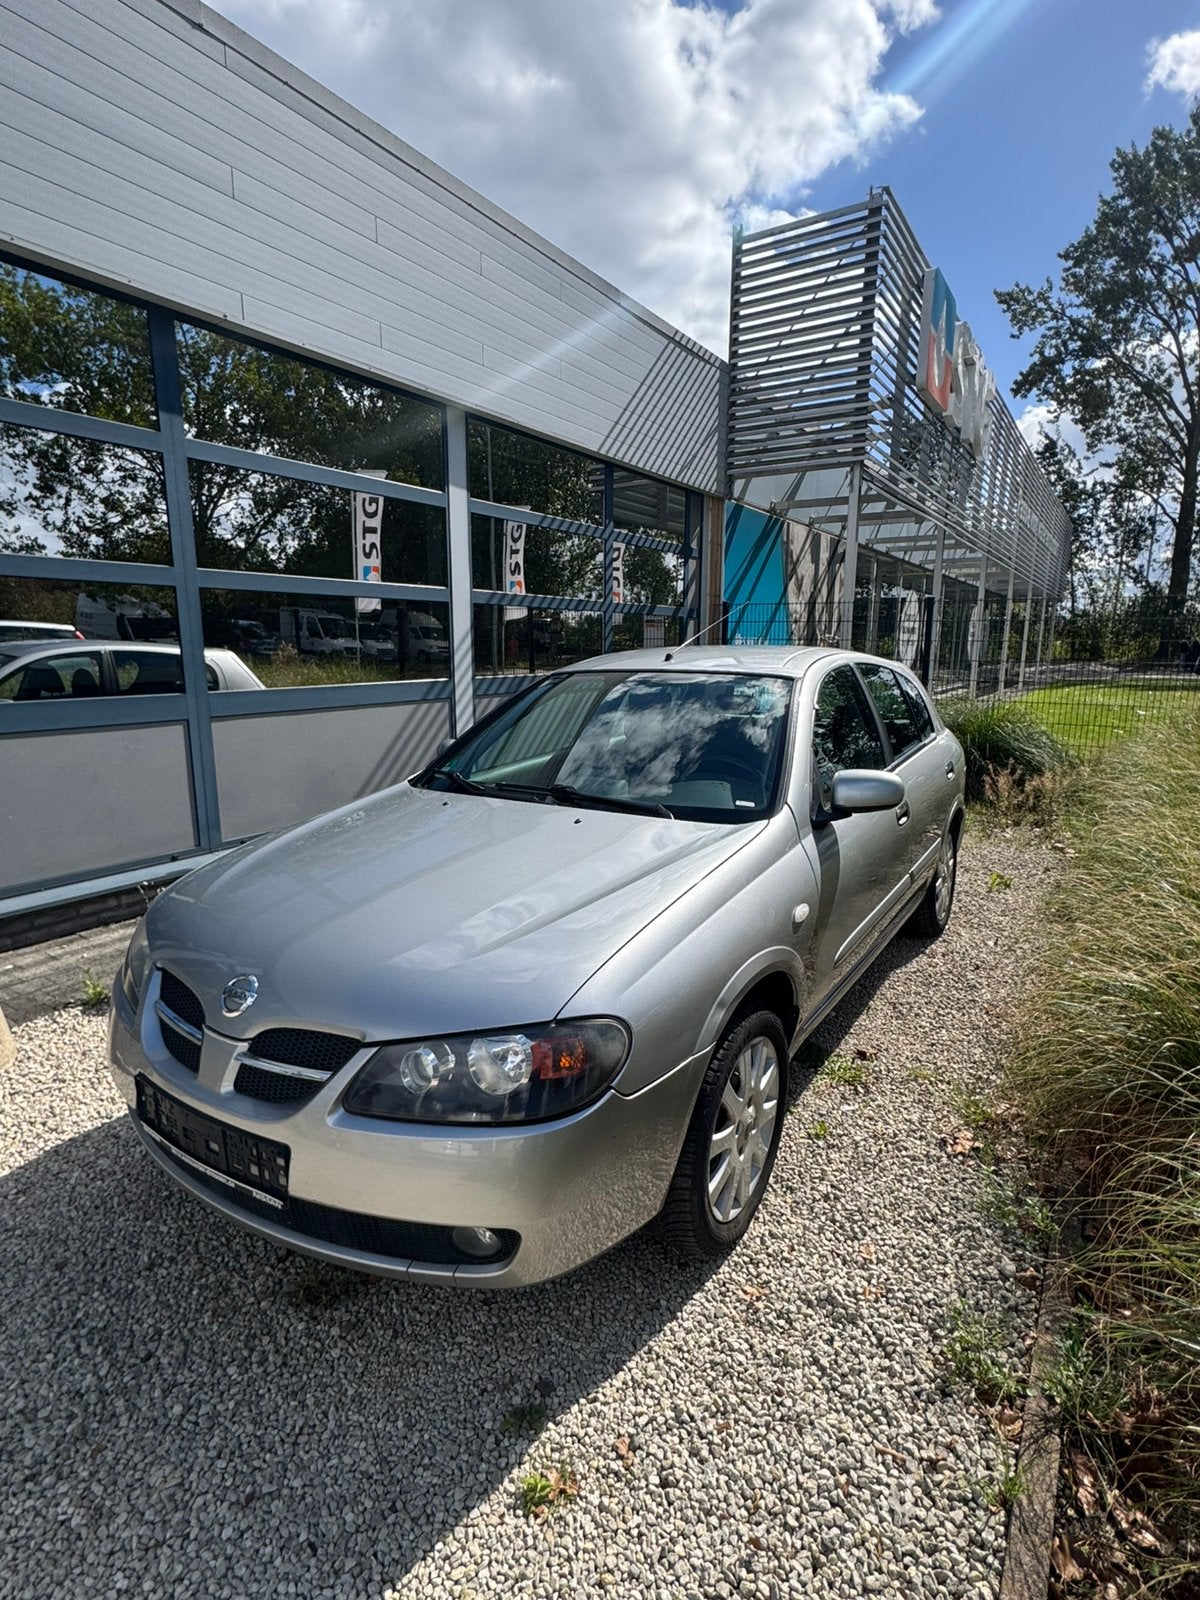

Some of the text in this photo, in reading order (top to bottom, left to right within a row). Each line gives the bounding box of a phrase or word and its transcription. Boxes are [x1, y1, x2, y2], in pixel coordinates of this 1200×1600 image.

[362, 497, 379, 559] STG
[509, 524, 523, 576] STG
[252, 1191, 283, 1209] NISSAN
